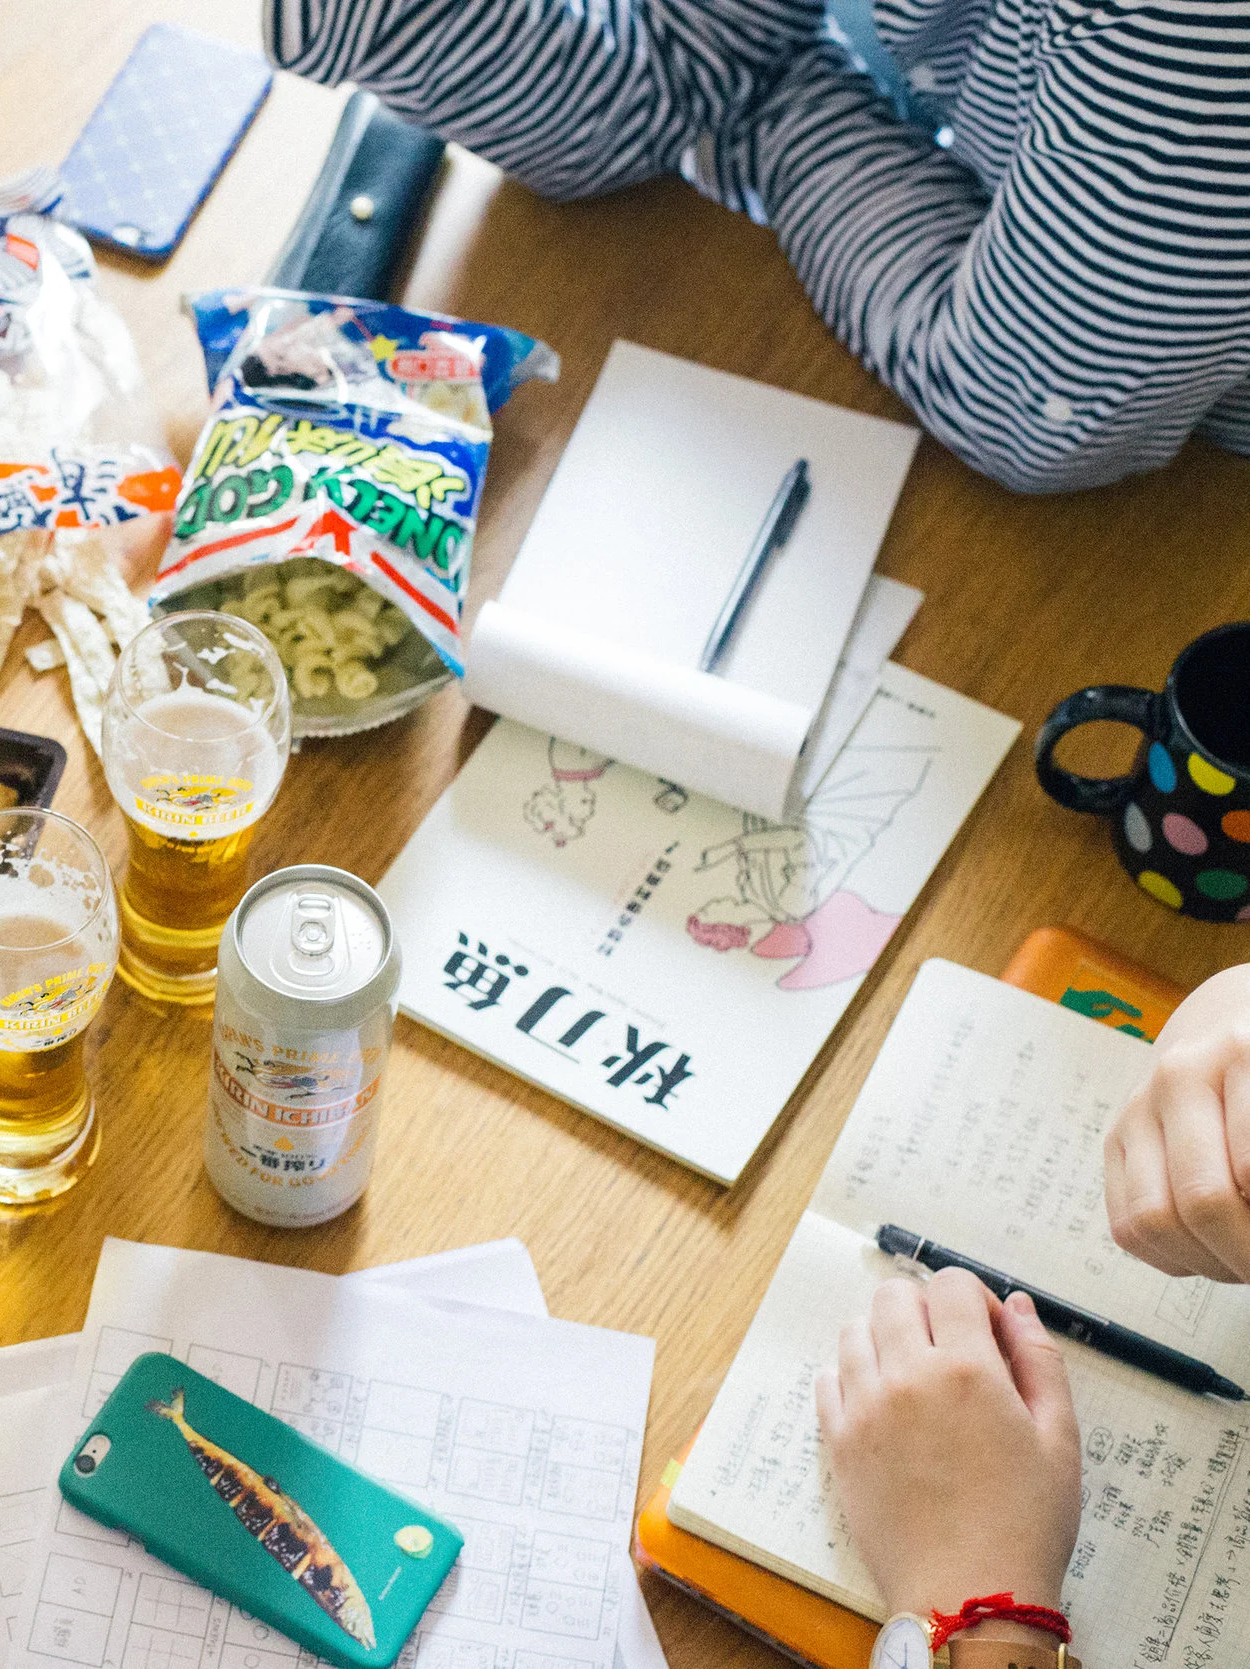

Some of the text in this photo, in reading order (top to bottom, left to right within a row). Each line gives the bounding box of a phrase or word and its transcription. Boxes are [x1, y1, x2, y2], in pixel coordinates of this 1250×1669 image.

[173, 464, 294, 542] GOD
[145, 801, 198, 825] KIRIN
[3, 1014, 63, 1031] KIRIN
[440, 929, 698, 1112] 秋刀魚
